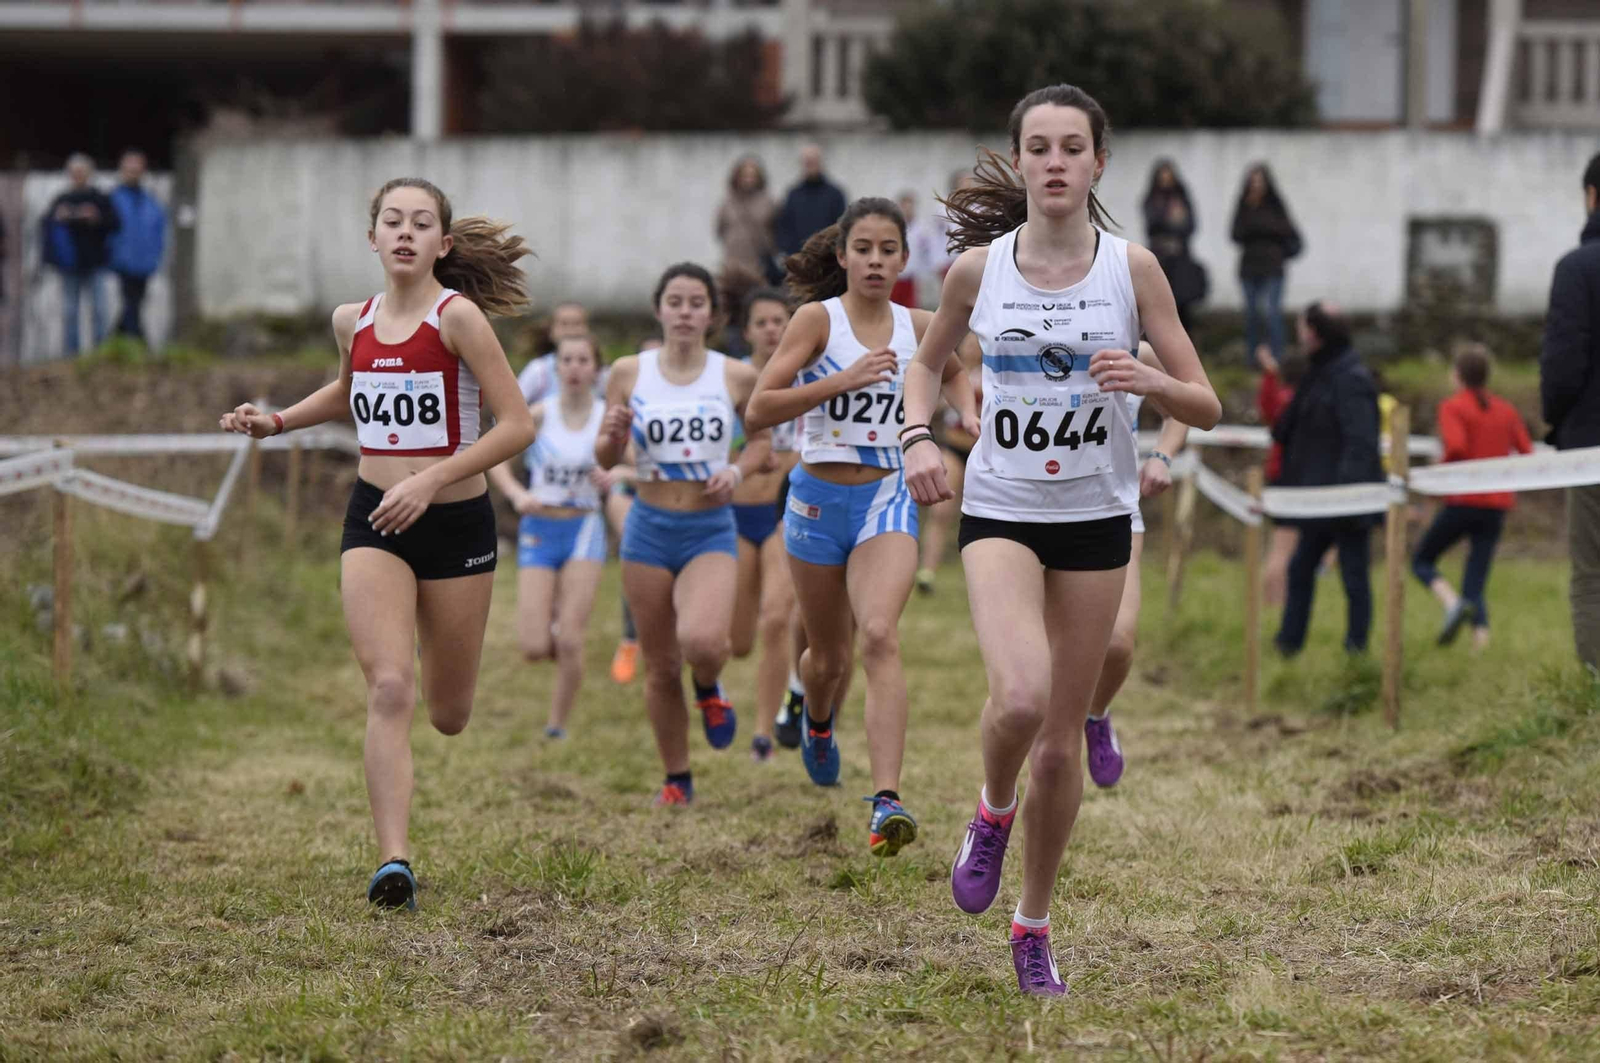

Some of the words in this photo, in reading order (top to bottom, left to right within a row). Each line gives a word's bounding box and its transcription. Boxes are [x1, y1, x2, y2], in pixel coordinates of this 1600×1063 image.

[353, 392, 441, 426] 0408
[648, 417, 724, 444] 0283
[995, 407, 1108, 452] 0644
